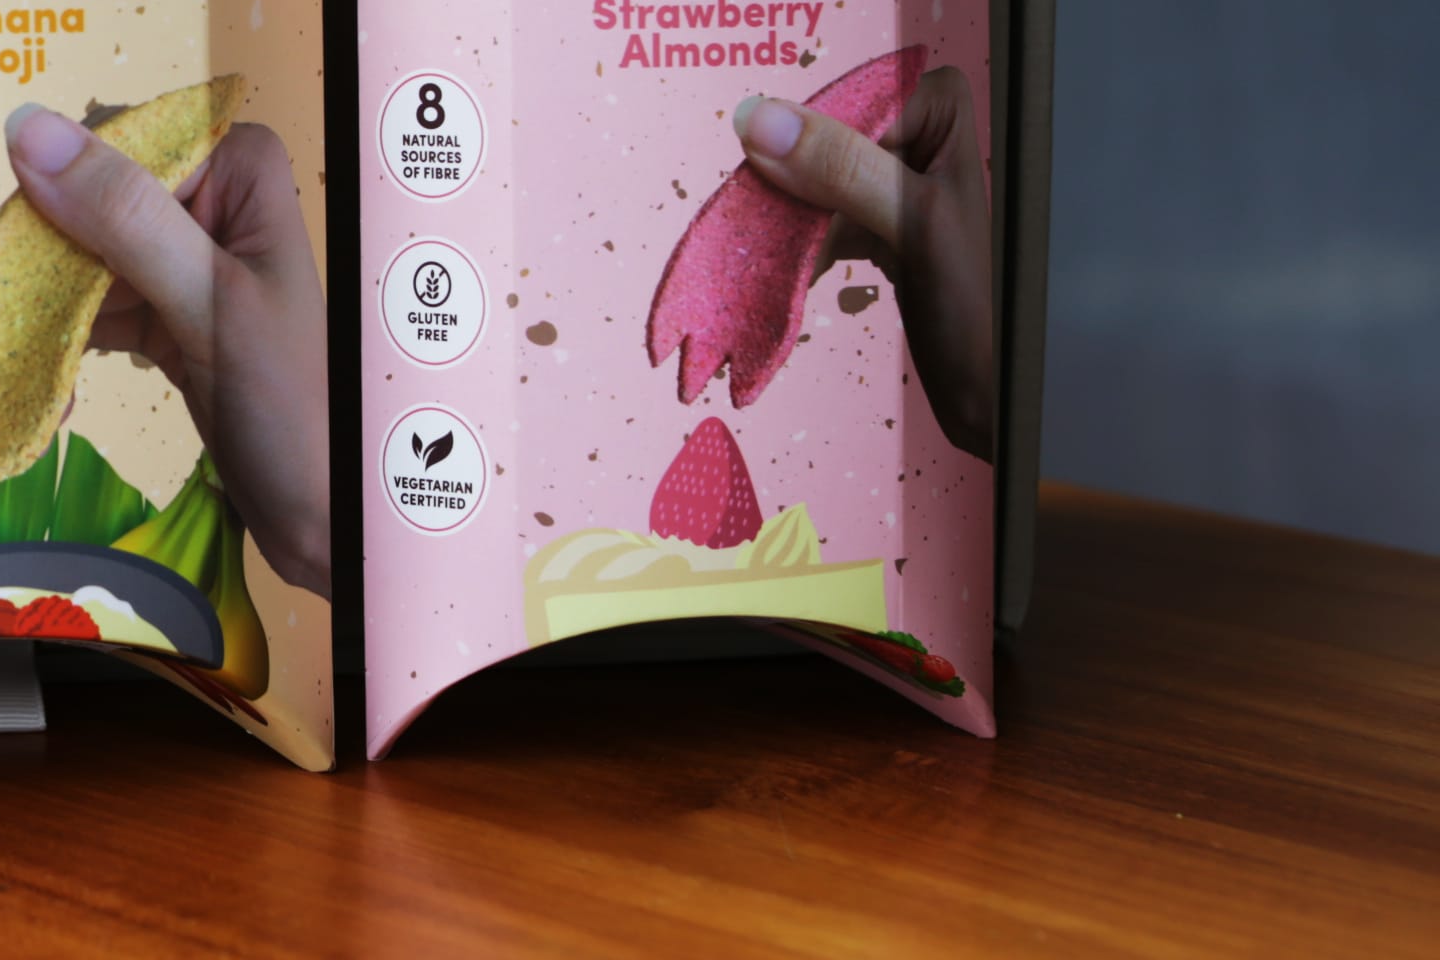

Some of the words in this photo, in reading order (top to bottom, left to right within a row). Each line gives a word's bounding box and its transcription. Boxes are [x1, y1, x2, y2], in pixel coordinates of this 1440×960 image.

[619, 30, 798, 68] Almonds
[416, 83, 445, 129] 8
[402, 135, 461, 147] NATURAL
[401, 150, 462, 164] SOURCES
[403, 166, 421, 179] OF
[424, 167, 460, 180] FIBRE
[407, 312, 458, 326] GLUTEN
[418, 328, 448, 342] FREE
[394, 476, 474, 495] VEGETARIAN
[400, 493, 466, 510] CERTIFIED
